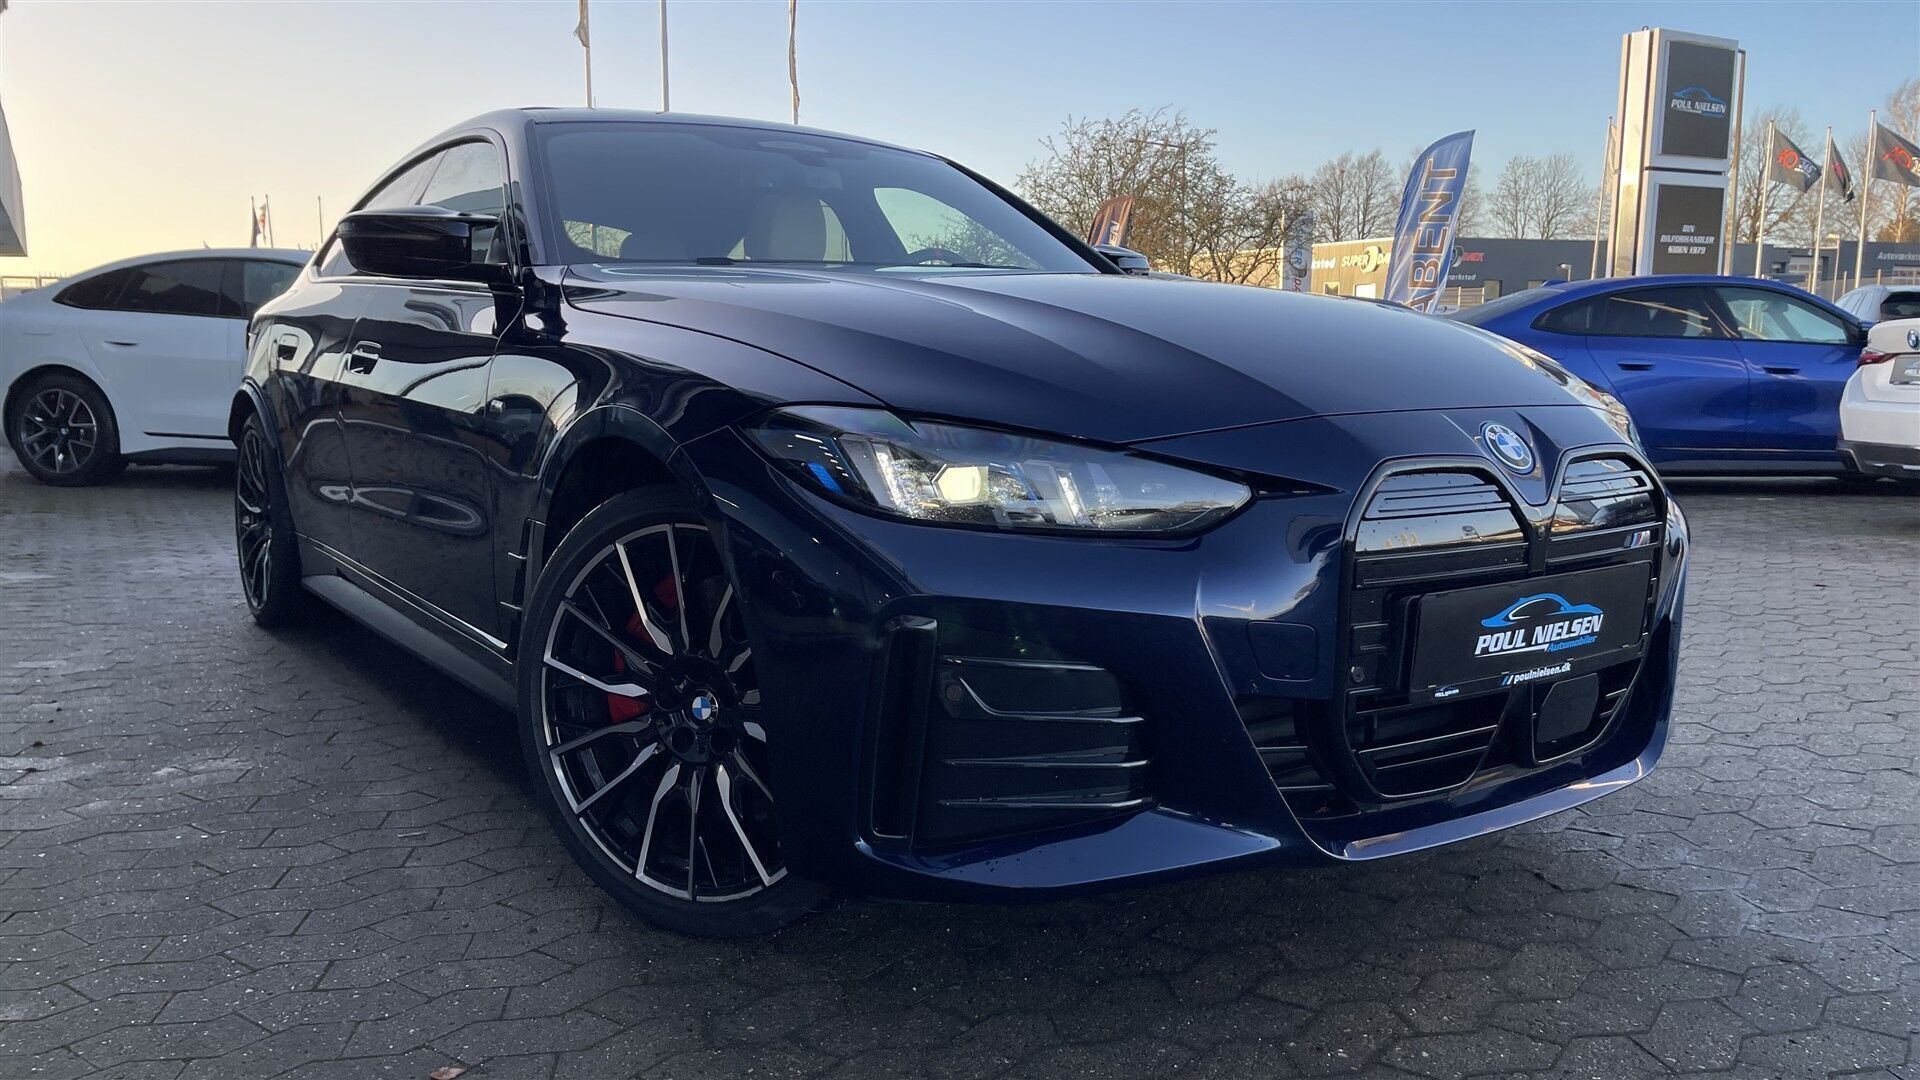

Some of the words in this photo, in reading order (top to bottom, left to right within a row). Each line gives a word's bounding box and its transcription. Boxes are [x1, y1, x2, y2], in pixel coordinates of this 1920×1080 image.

[1671, 98, 1693, 110] POUL
[1694, 101, 1727, 114] NIELSEN
[1660, 234, 1715, 244] BILFORHANDLER
[1667, 245, 1688, 254] SIDEN
[1341, 254, 1369, 267] SUPER
[1474, 628, 1526, 655] POUL
[1531, 614, 1604, 645] NIELSEN
[1548, 634, 1597, 653] Automobiler
[1513, 661, 1572, 685] poulnielsen.dk
